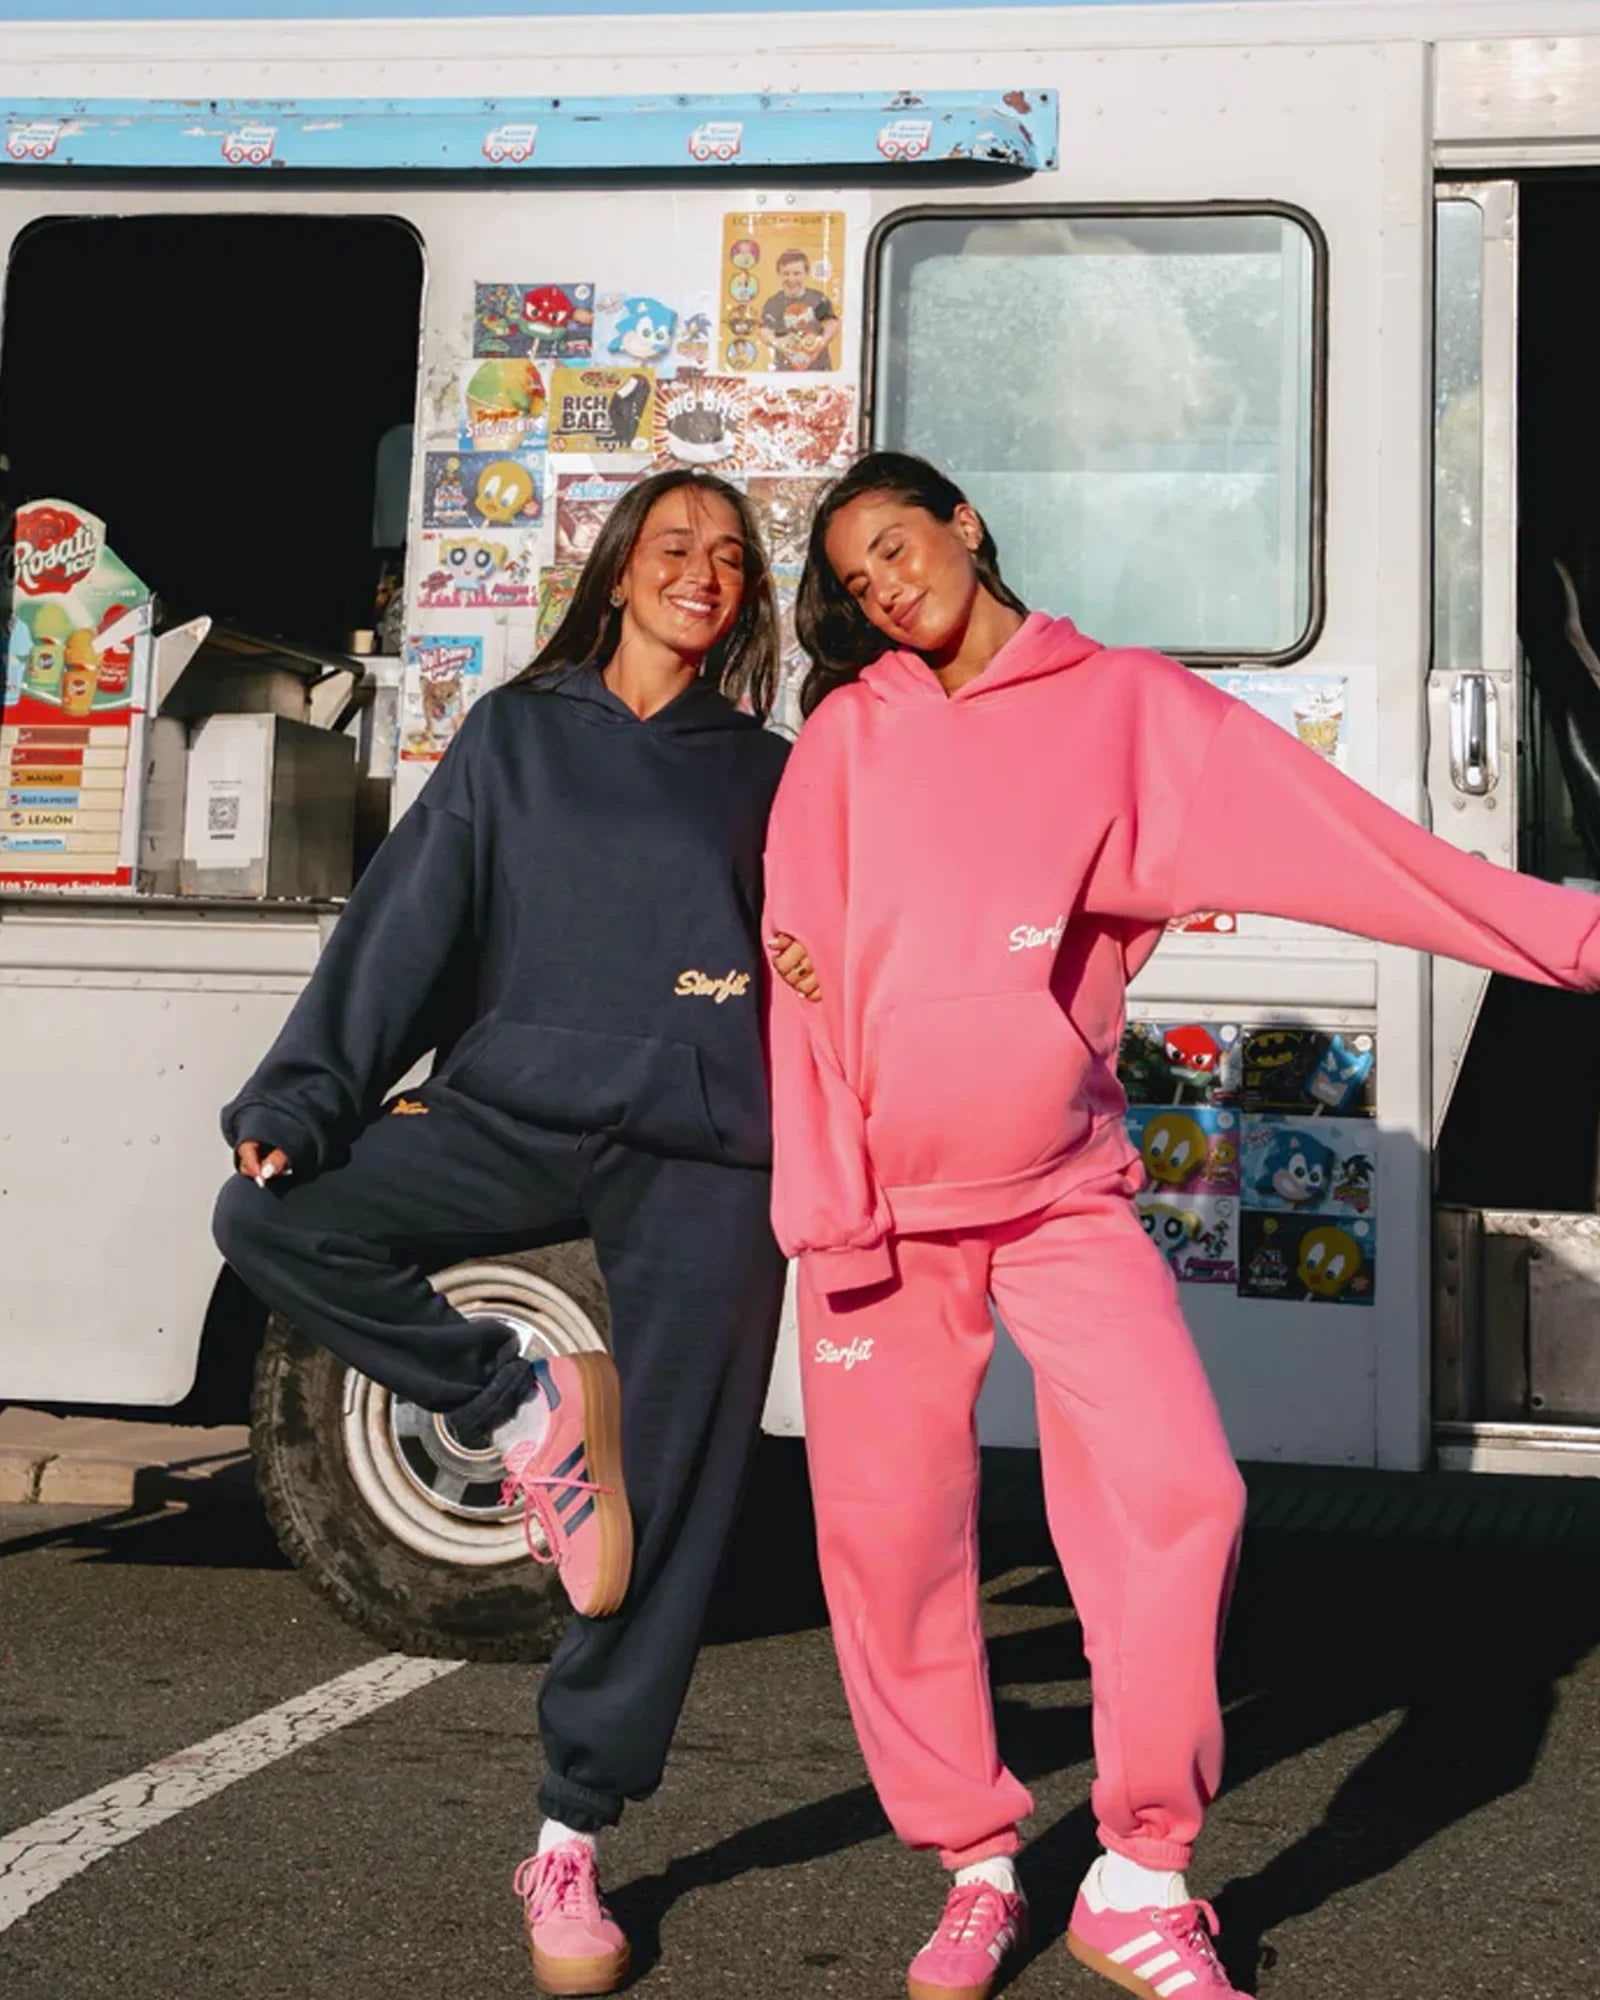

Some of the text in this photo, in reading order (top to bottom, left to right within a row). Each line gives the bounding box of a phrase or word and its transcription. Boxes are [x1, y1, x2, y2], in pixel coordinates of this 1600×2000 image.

[563, 395, 607, 411] RICH
[667, 391, 697, 420] BIG
[14, 522, 98, 590] Rosati
[28, 815, 74, 825] LEMON
[1008, 914, 1066, 952] Starf
[814, 1336, 875, 1371] Starfit
